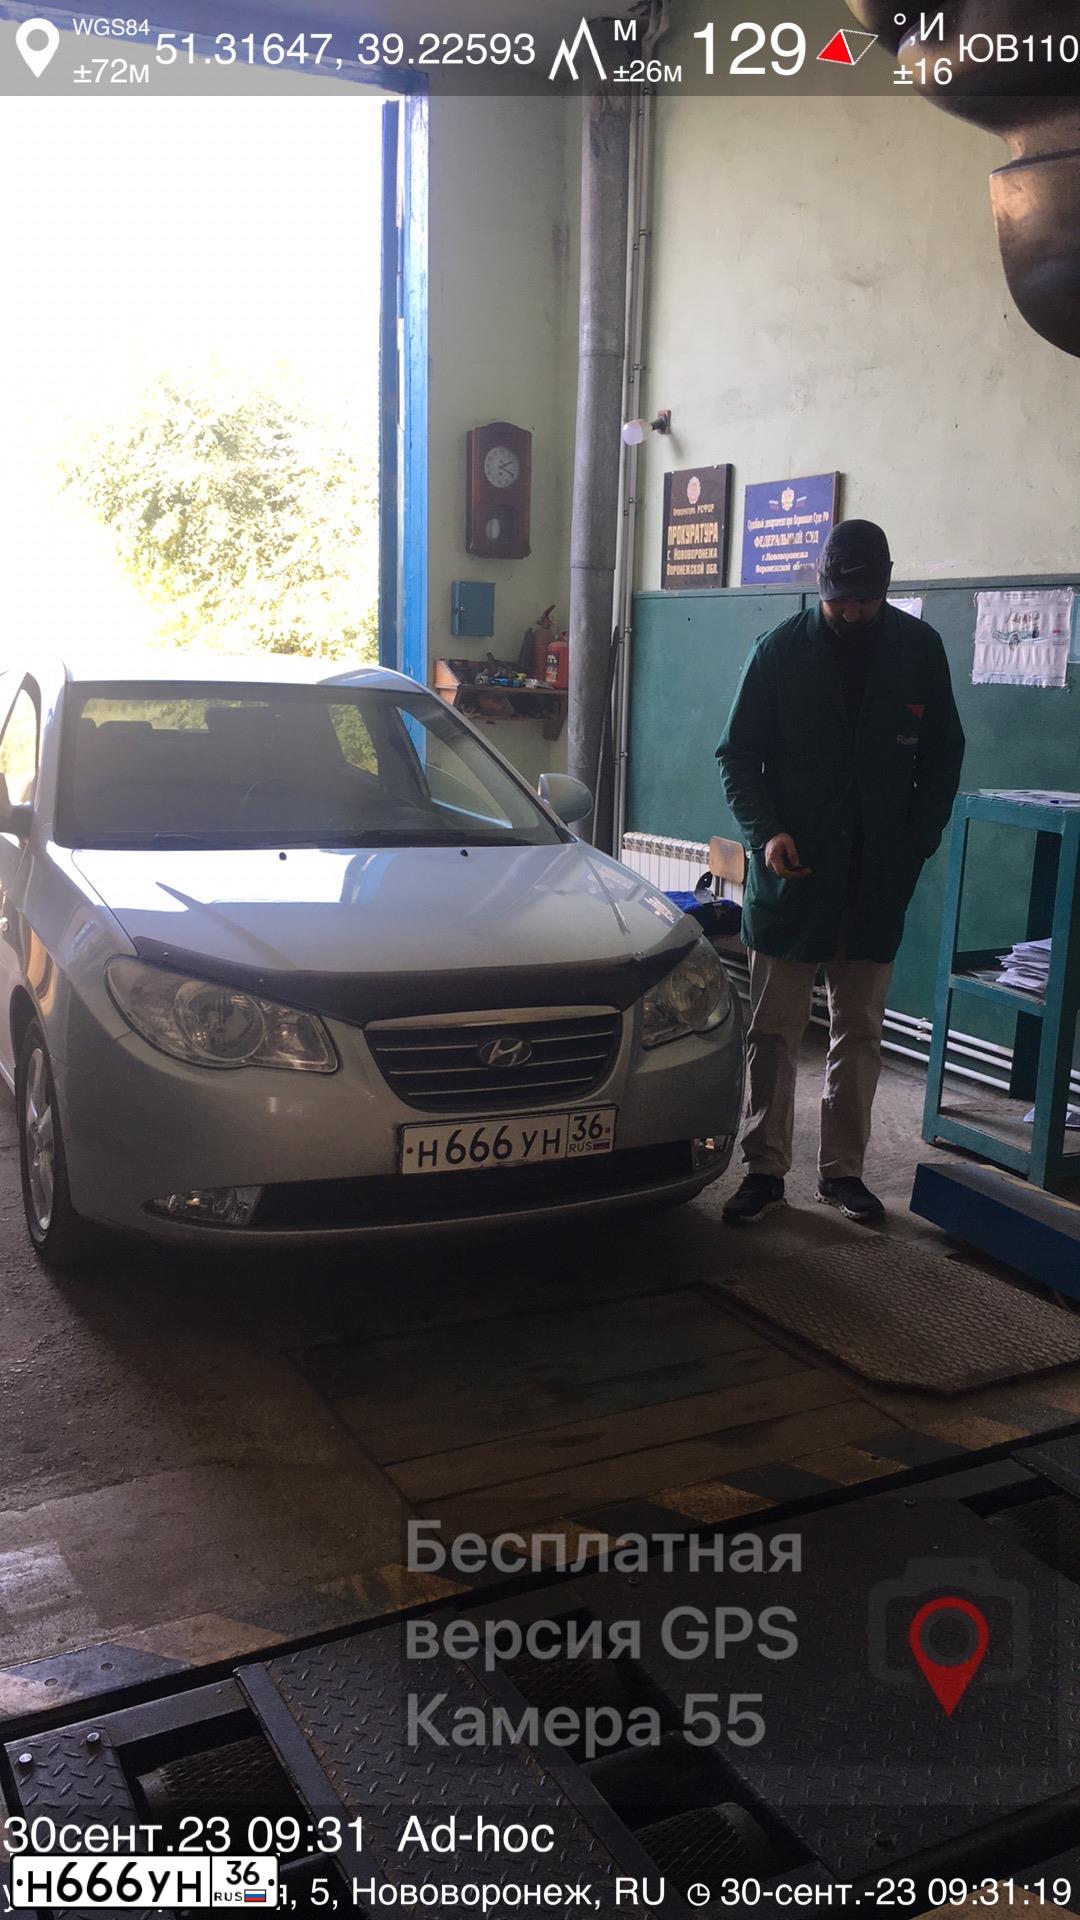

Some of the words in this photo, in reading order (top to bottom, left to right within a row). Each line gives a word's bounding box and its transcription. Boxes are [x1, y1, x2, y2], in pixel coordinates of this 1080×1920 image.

[667, 521, 719, 546] ПРОКУРАТУРА
[753, 529, 803, 548] ФЕДЕРАЛЬНЫЙ
[804, 530, 820, 545] СУД
[571, 1113, 602, 1142] 36
[568, 1140, 594, 1153] RUS
